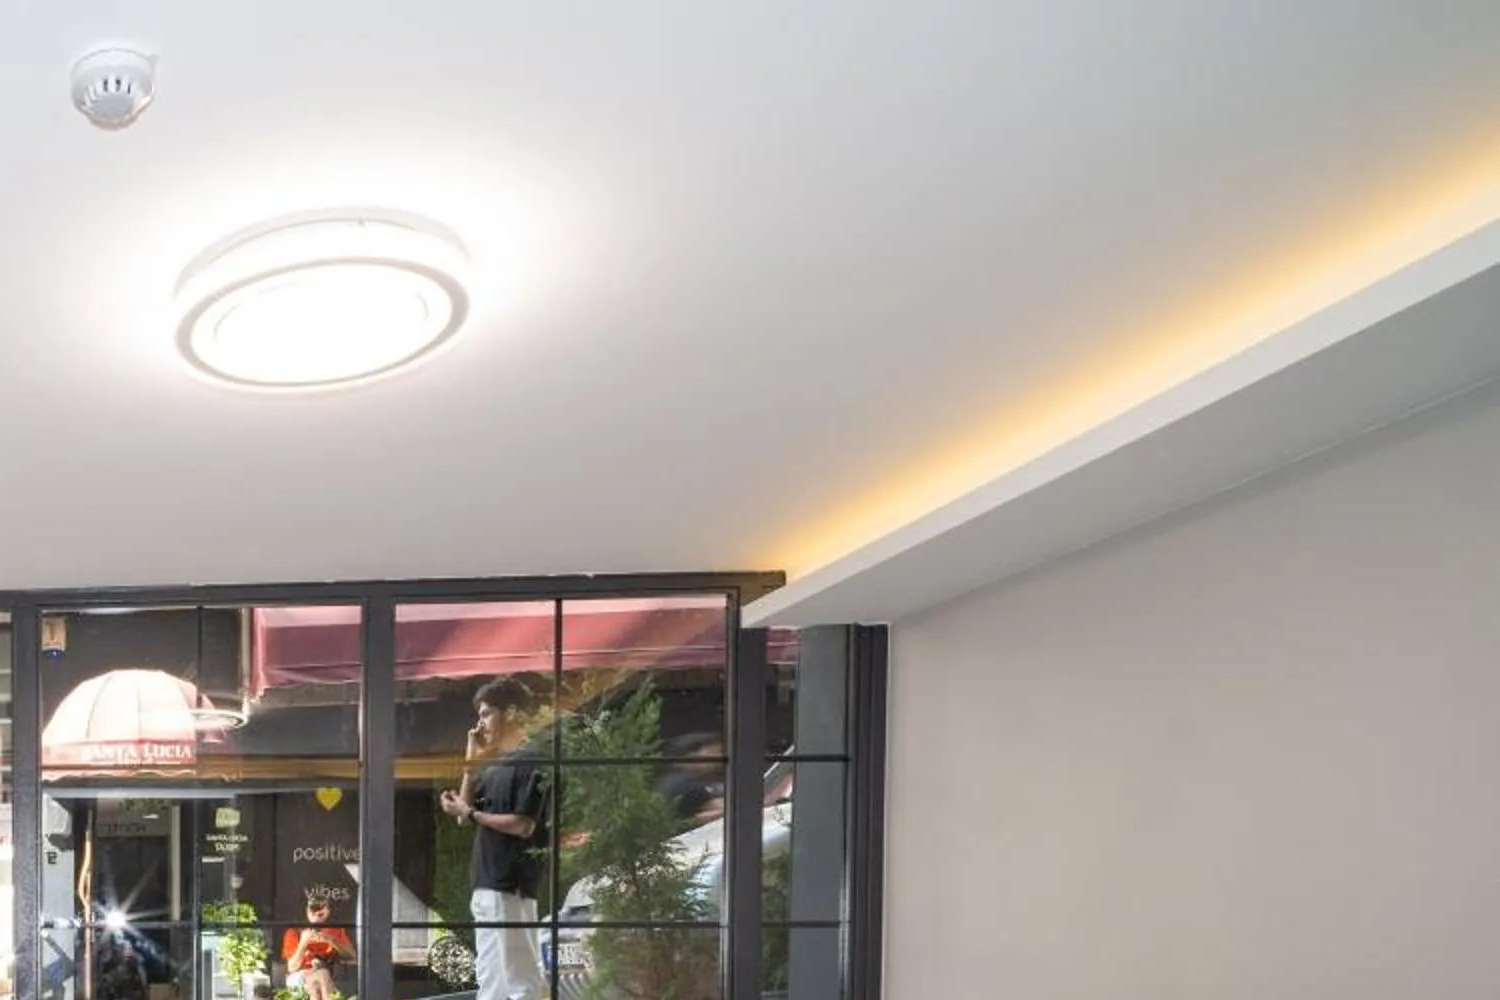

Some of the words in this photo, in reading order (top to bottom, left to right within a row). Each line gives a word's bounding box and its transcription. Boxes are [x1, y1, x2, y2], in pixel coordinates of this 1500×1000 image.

[143, 743, 192, 759] LUCIA
[293, 843, 361, 864] positive
[304, 884, 350, 900] vibes
